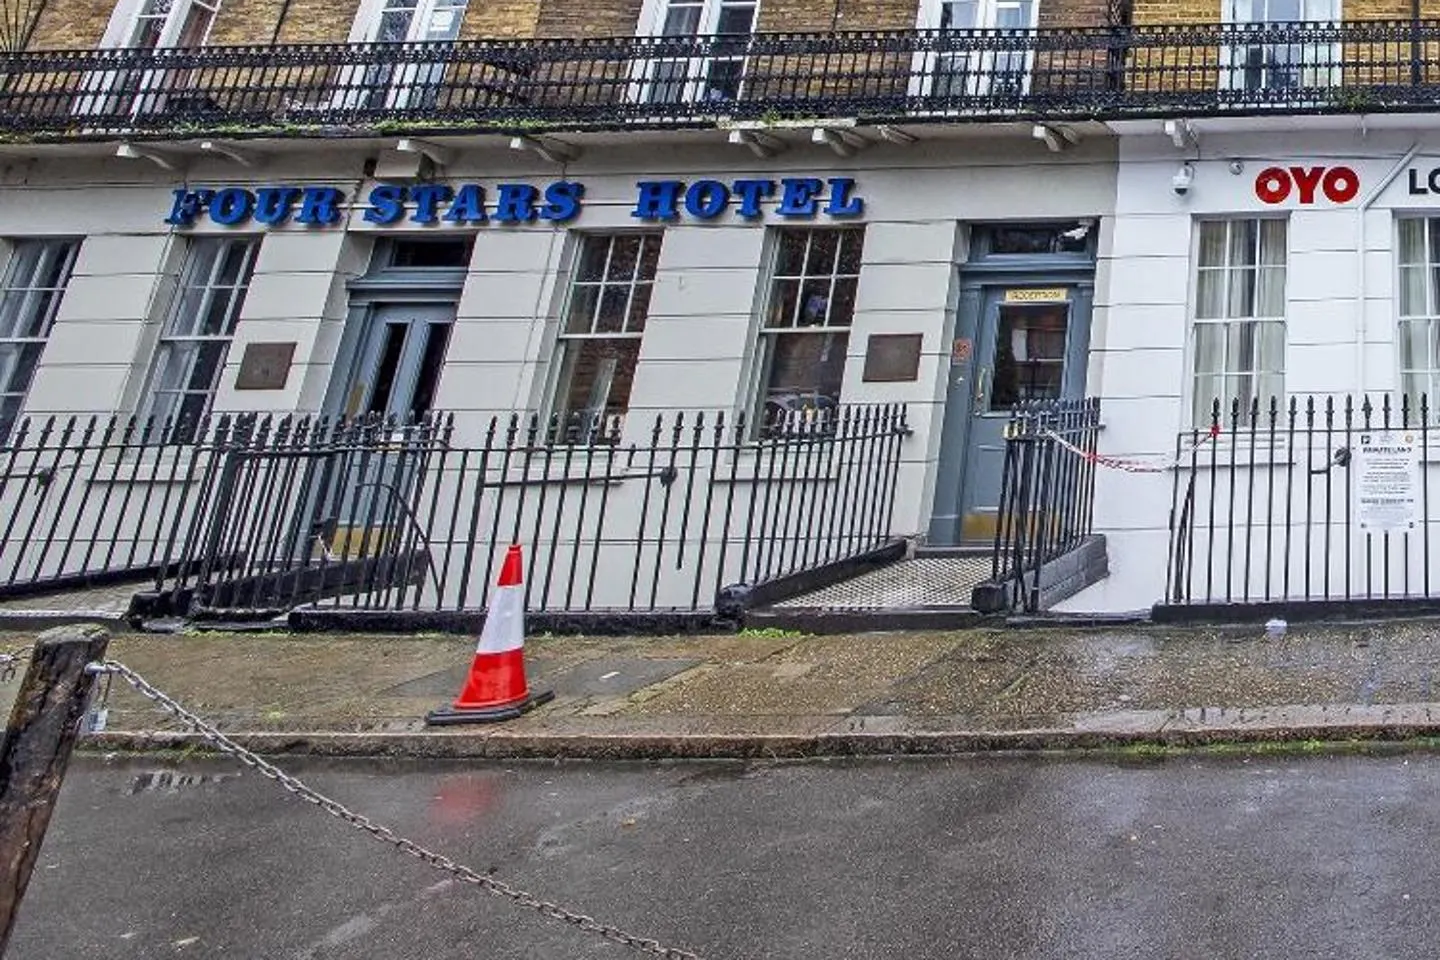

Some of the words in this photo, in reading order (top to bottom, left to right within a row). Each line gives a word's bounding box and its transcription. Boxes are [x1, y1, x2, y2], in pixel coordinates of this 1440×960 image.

[165, 186, 342, 226] FOUR
[363, 180, 585, 224] STARS
[631, 178, 865, 219] HOTEL
[1254, 166, 1361, 204] OYO
